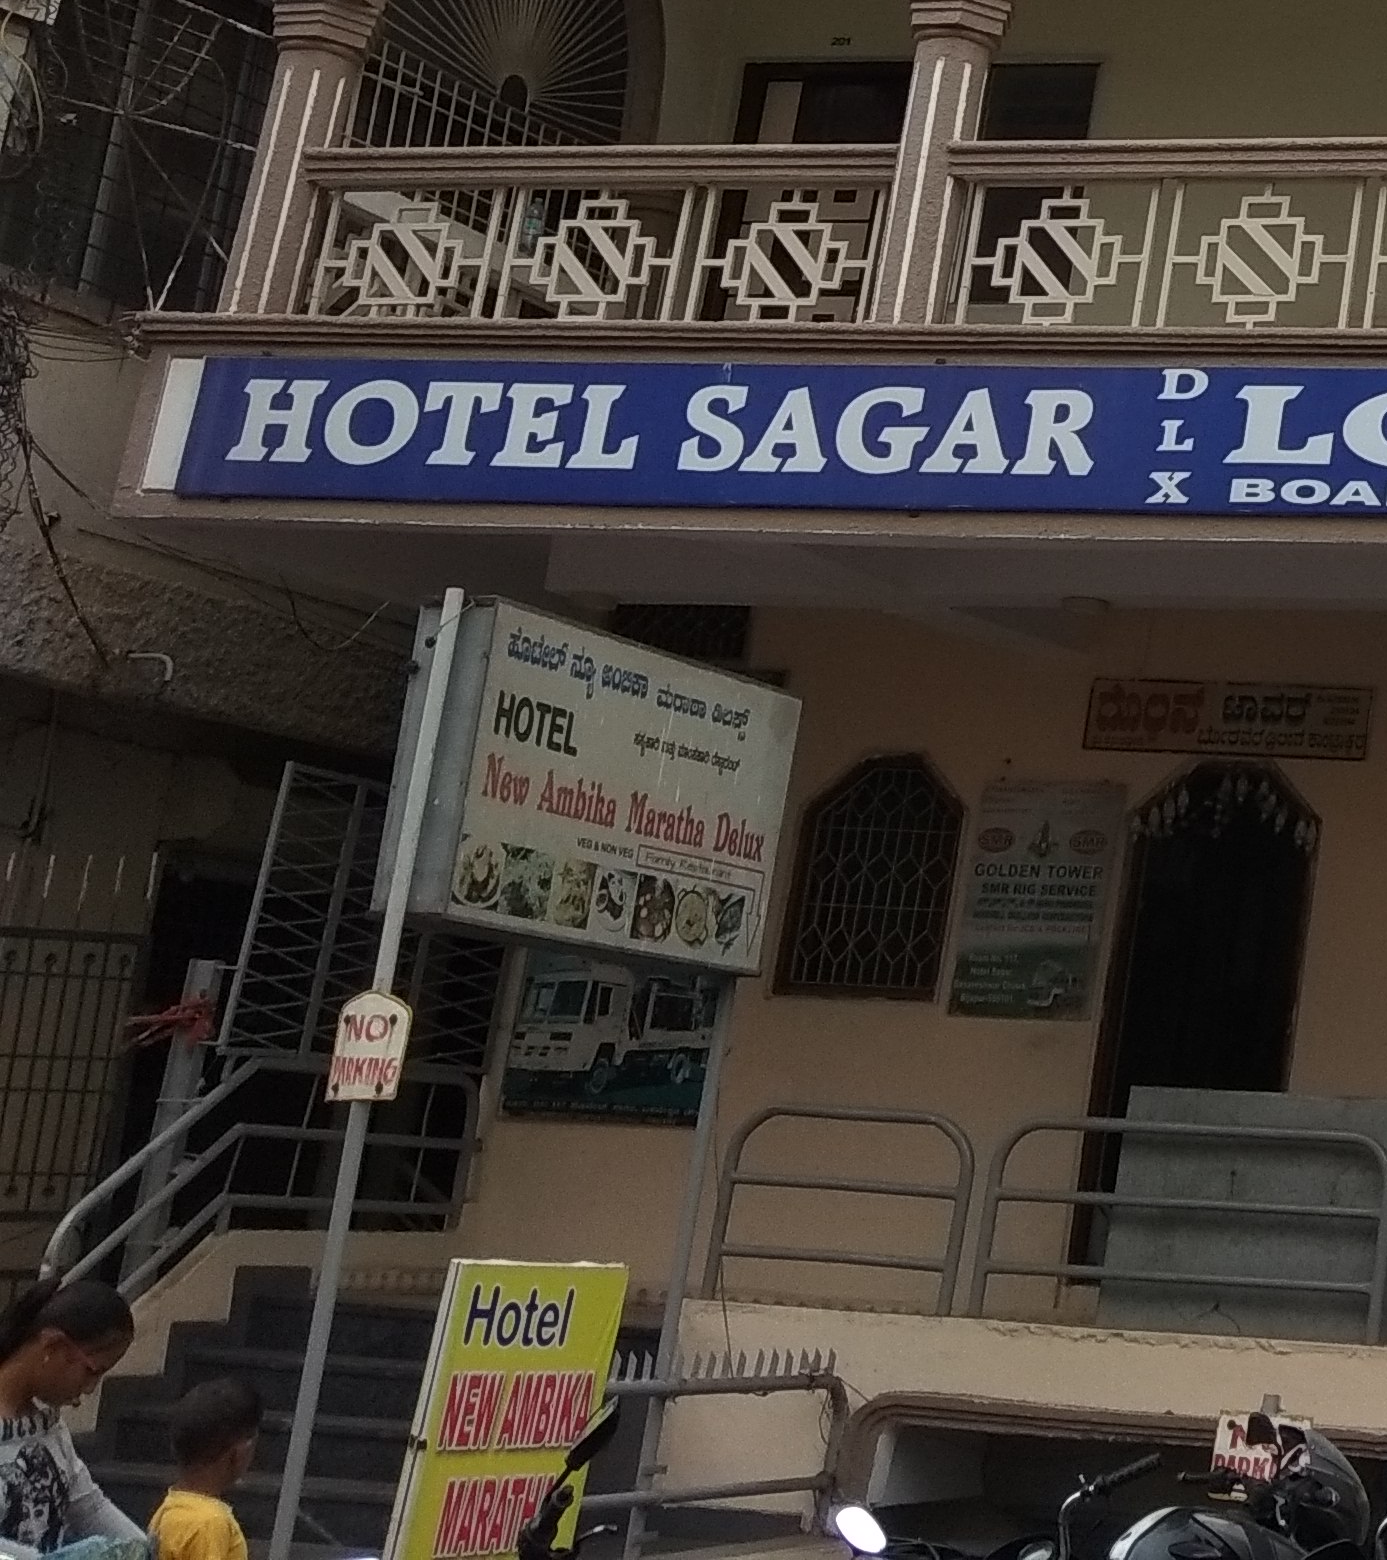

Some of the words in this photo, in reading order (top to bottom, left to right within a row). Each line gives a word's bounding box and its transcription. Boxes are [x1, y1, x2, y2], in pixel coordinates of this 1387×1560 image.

[831, 37, 851, 46] 201
[225, 378, 640, 470] HOTEL
[676, 384, 1095, 476] SAGAR
[493, 689, 578, 757] HOTEL
[482, 752, 531, 805] New
[536, 770, 617, 829] Ambika
[625, 791, 706, 849] Maratha
[711, 812, 767, 863] Delux
[576, 837, 593, 850] VEG
[601, 842, 617, 855] NON
[618, 846, 635, 859] VEG
[974, 863, 1041, 879] GOLDEN
[1048, 865, 1104, 880] TOWER
[1040, 884, 1097, 897] SERVICE
[346, 1014, 389, 1042] NO
[332, 1055, 398, 1086] PARKING
[463, 1283, 576, 1347] Hotel
[436, 1371, 505, 1450] NEW
[493, 1370, 596, 1448] AMBIKA
[432, 1474, 555, 1558] MARATH
